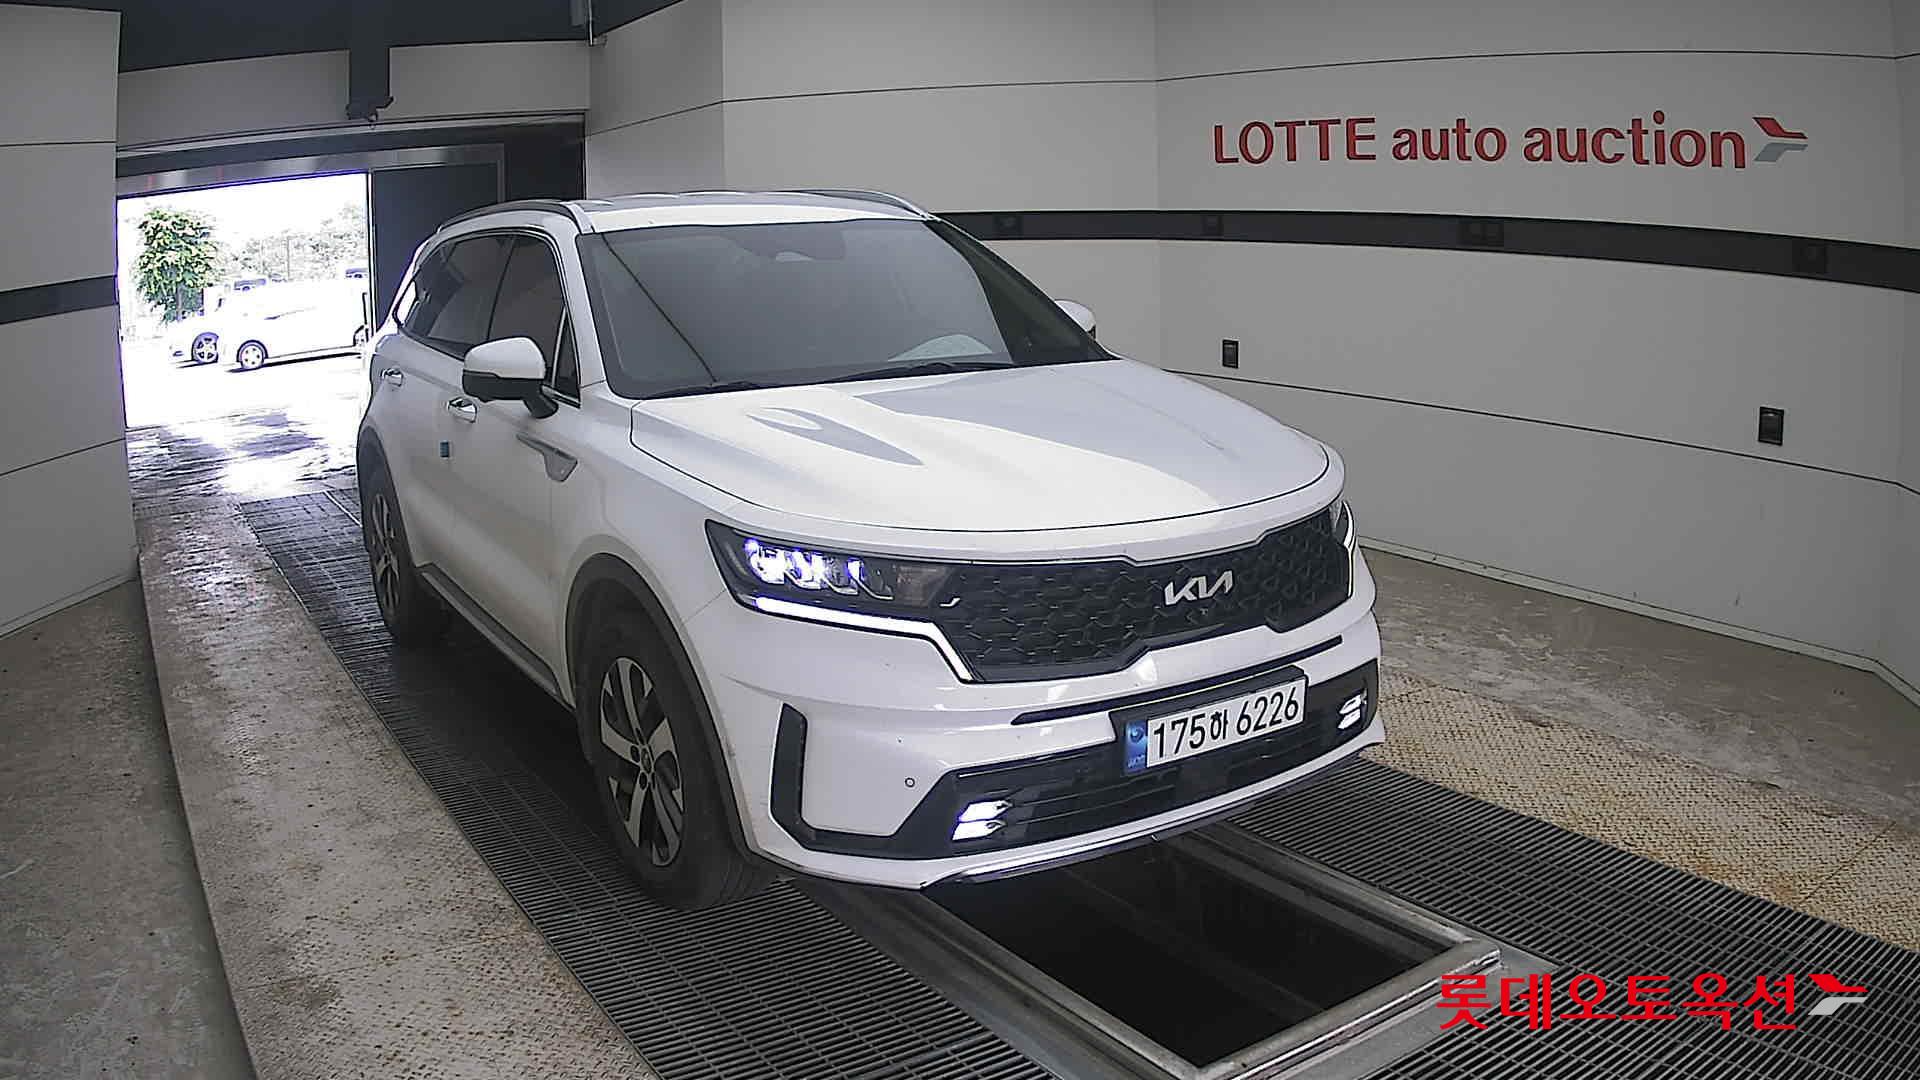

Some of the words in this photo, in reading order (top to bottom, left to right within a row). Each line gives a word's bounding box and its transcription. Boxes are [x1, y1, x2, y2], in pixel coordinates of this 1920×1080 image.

[1213, 117, 1377, 164] LOTTE
[1391, 117, 1508, 162] auto
[1523, 110, 1746, 168] auction
[1164, 570, 1234, 606] KIA
[1153, 709, 1228, 758] 175하
[1236, 686, 1299, 736] 6226
